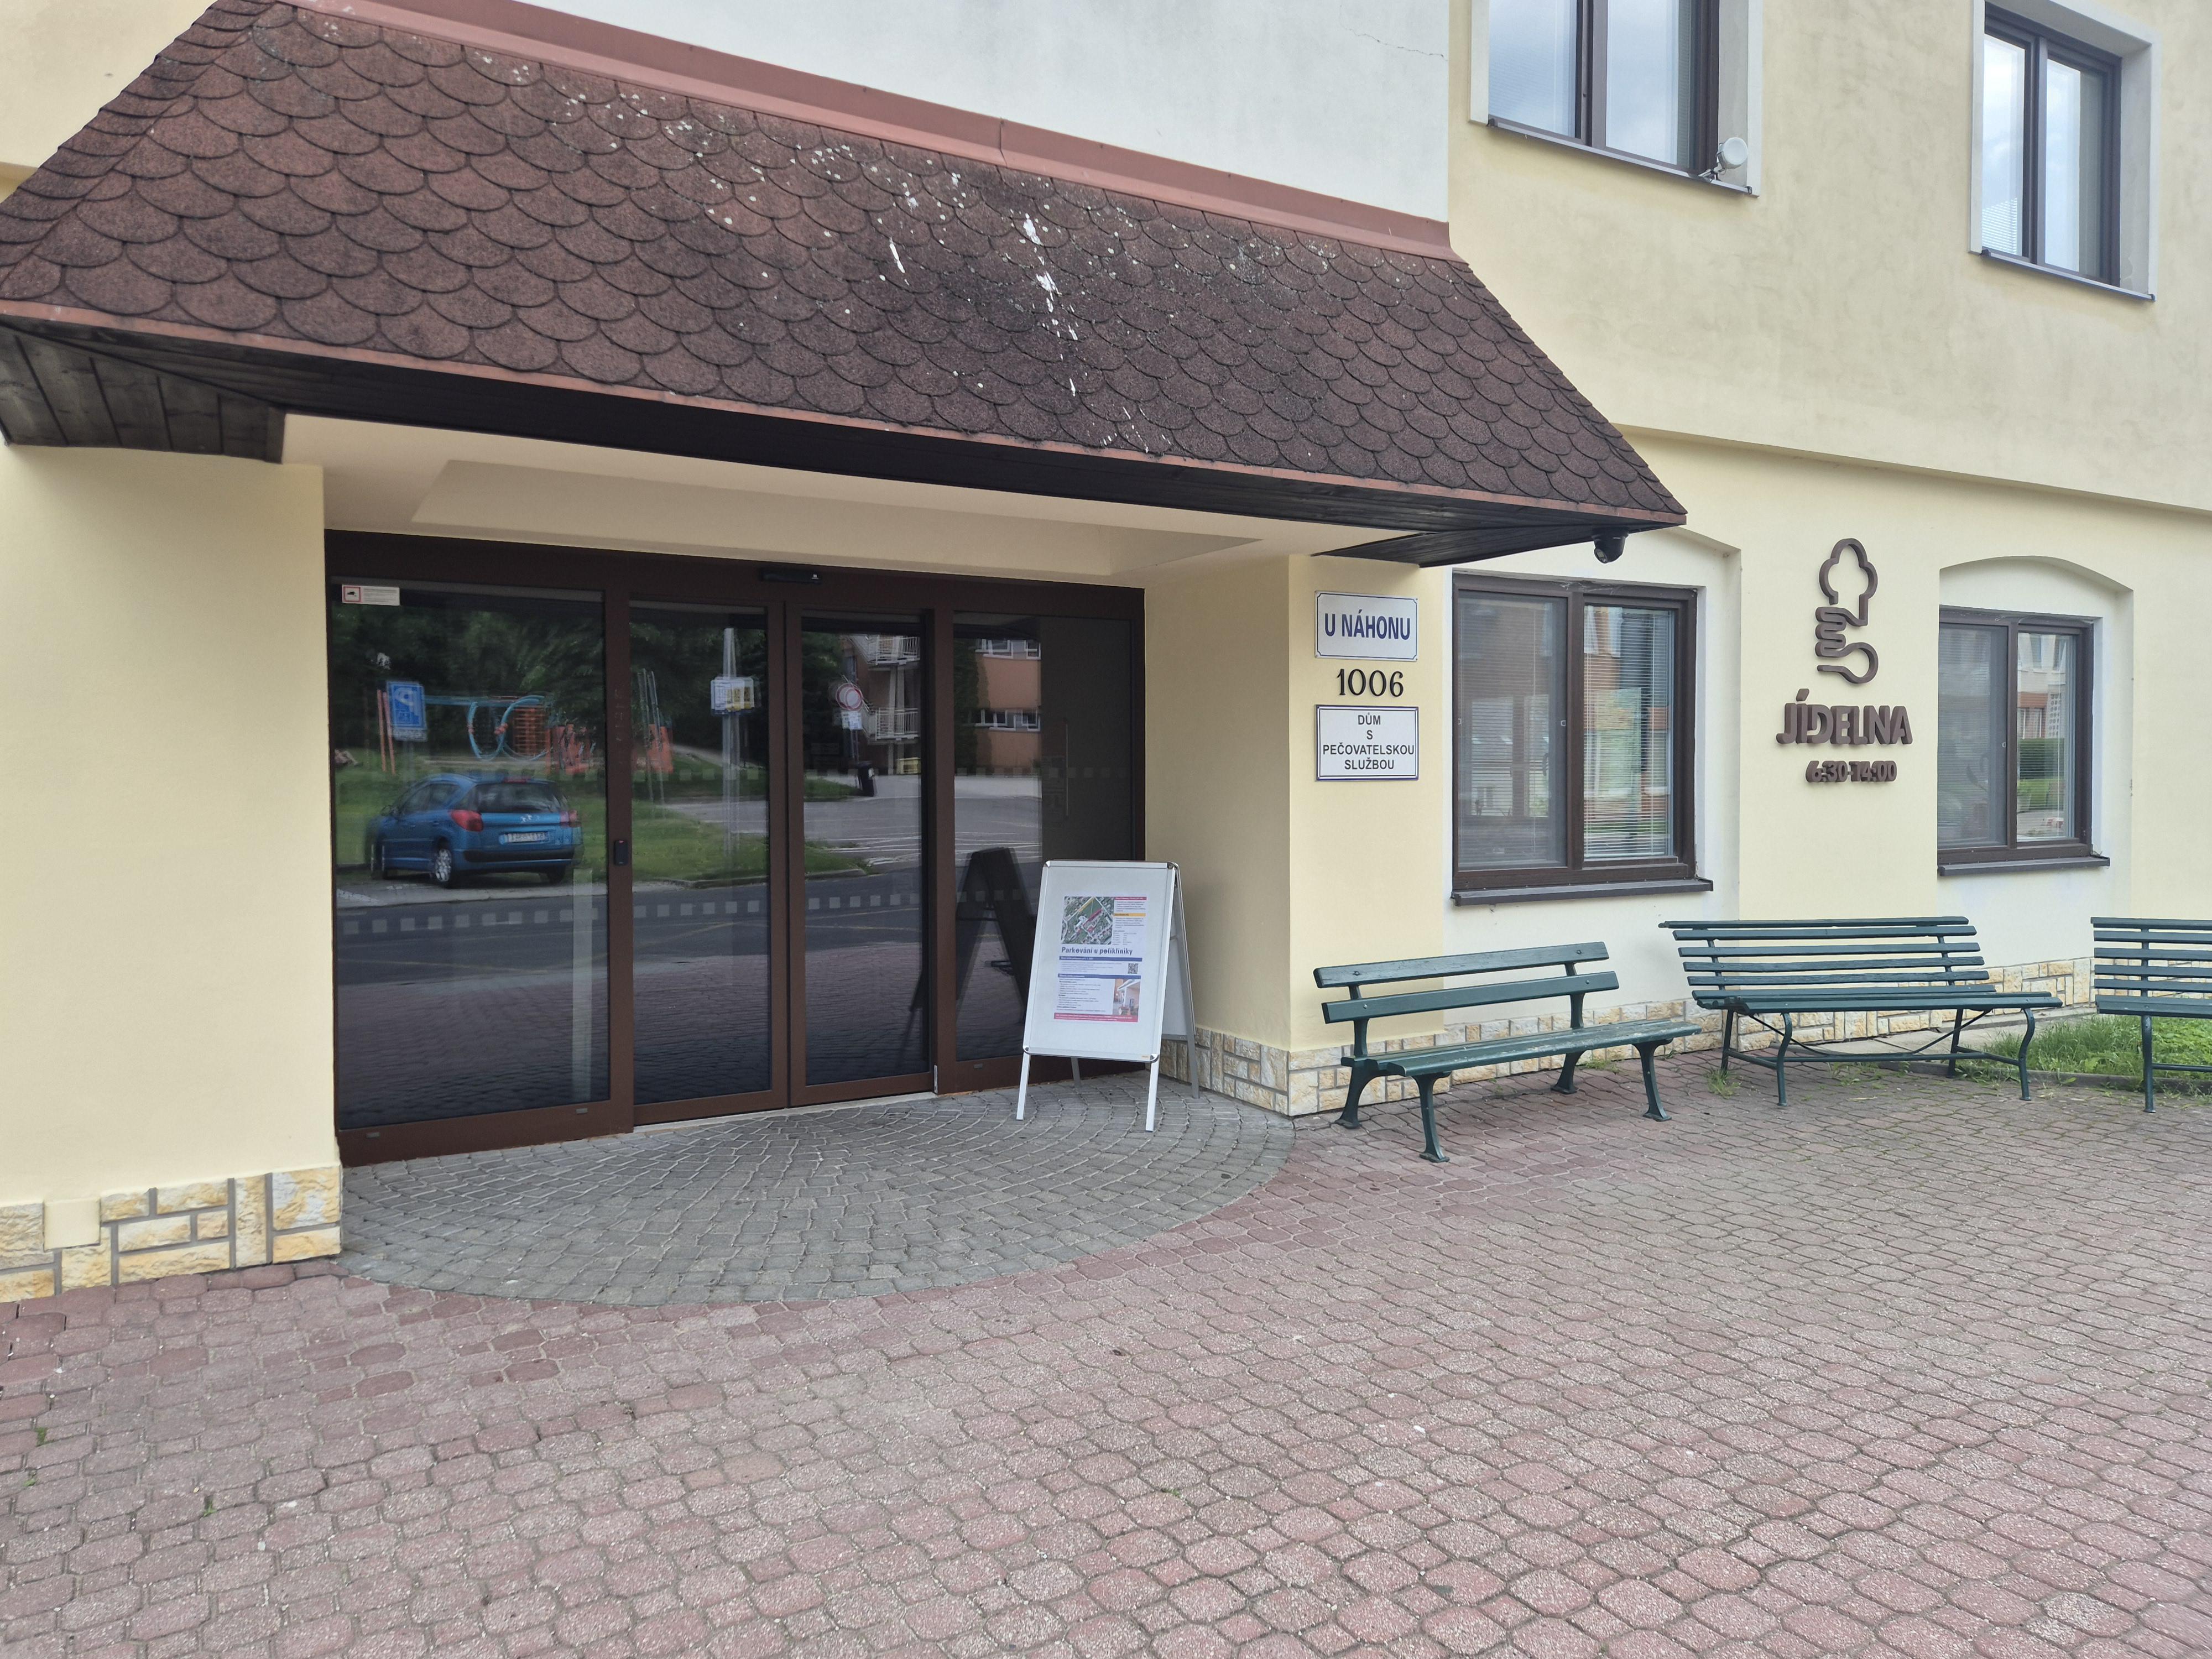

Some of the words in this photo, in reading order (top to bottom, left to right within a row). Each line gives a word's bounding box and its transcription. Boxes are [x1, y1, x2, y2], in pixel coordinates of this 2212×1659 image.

[1325, 613, 1335, 637] U
[1342, 609, 1411, 640] NÁHONU
[1337, 669, 1404, 697] 1006
[1358, 712, 1381, 726] DŮM
[1776, 688, 1913, 744] JÍDELNA
[1366, 729, 1373, 740] S
[1323, 742, 1415, 755] PEČOVATELSKOU
[1344, 757, 1395, 770] SLUŽBOU
